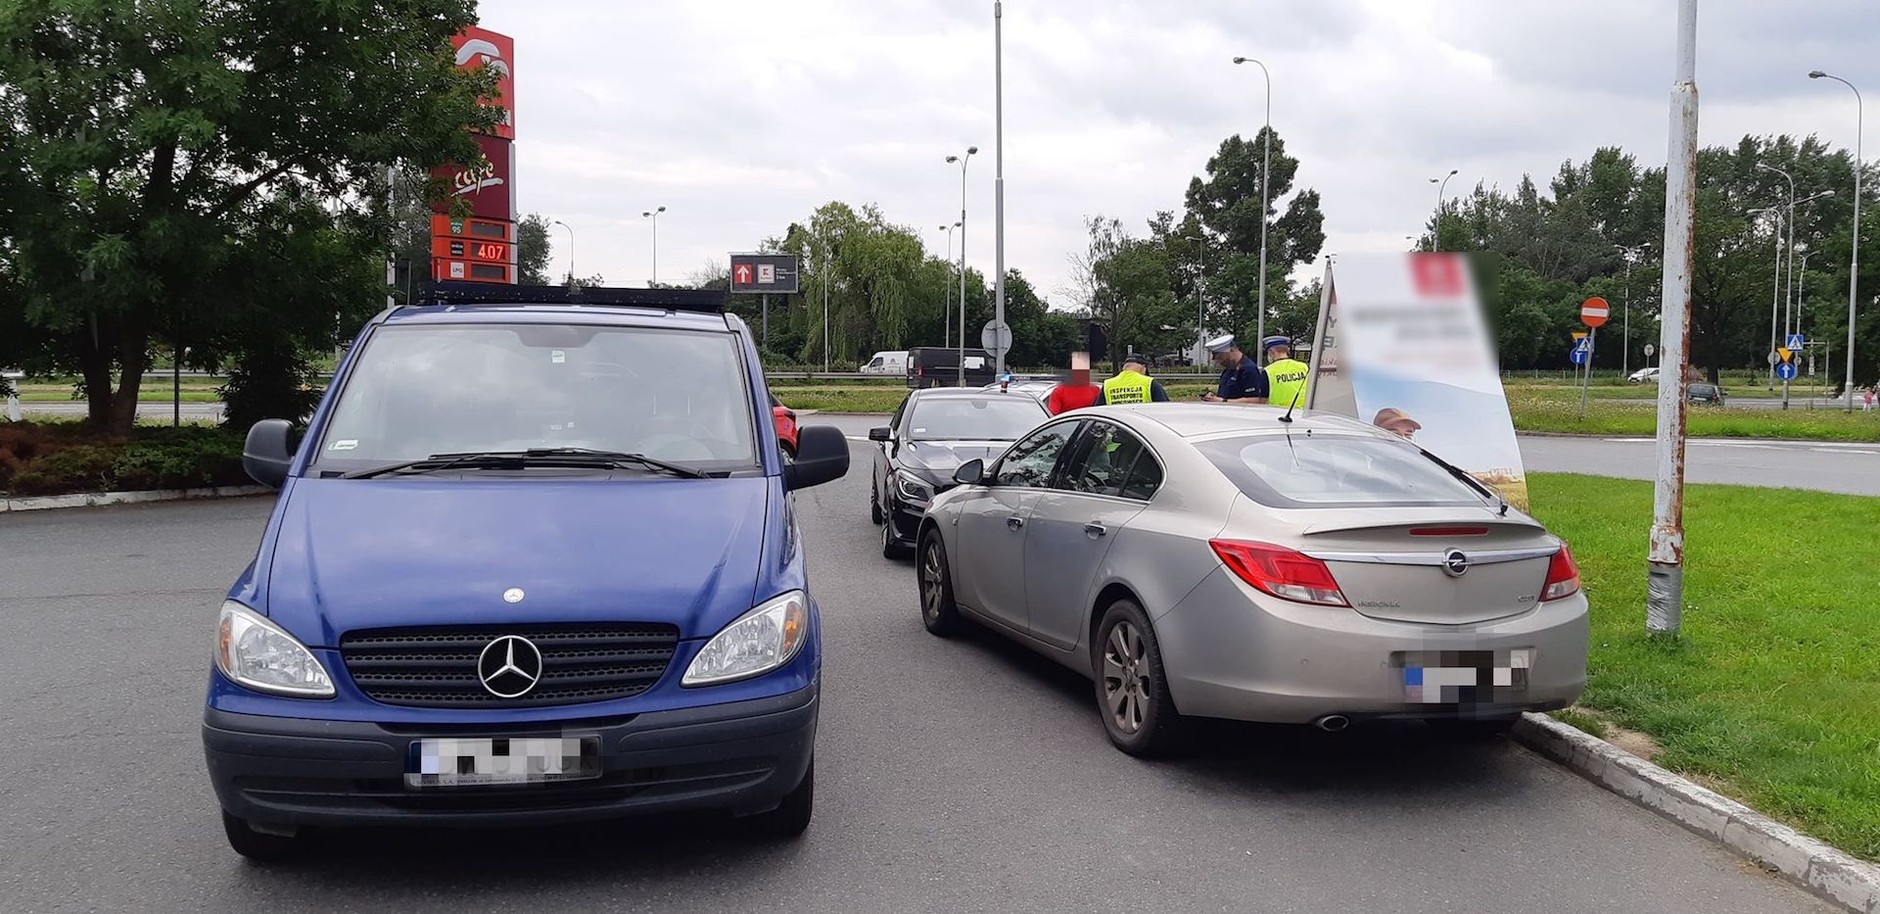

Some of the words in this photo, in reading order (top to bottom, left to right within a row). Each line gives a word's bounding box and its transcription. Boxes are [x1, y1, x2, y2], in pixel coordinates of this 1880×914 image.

[452, 226, 462, 234] 95
[478, 245, 504, 260] 4.07
[1276, 372, 1305, 383] POLICJA
[1110, 386, 1143, 394] INSPEKCJA
